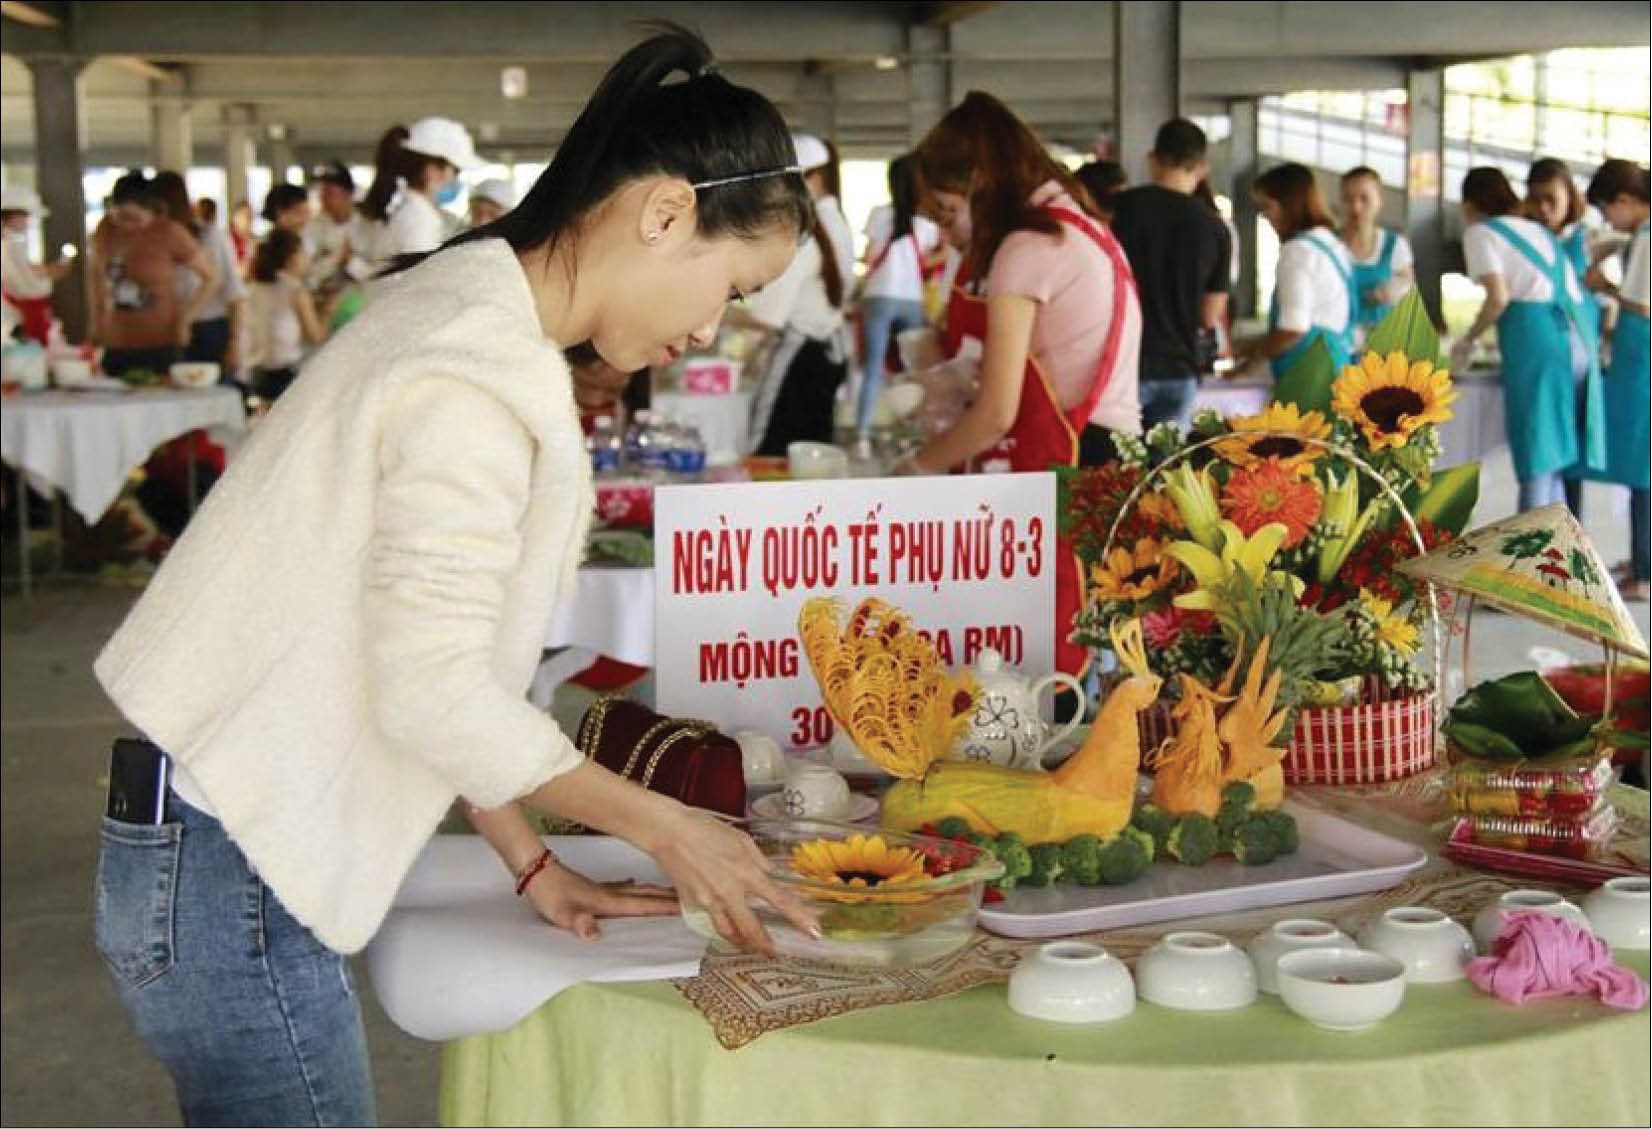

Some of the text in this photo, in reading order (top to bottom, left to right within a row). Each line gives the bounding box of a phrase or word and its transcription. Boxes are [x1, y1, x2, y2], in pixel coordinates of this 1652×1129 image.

[673, 502, 1043, 597] NGÀY QUỐC TẾ PHỤ NỮ 8-3
[700, 631, 799, 688] MỘNG
[791, 707, 834, 745] 30
